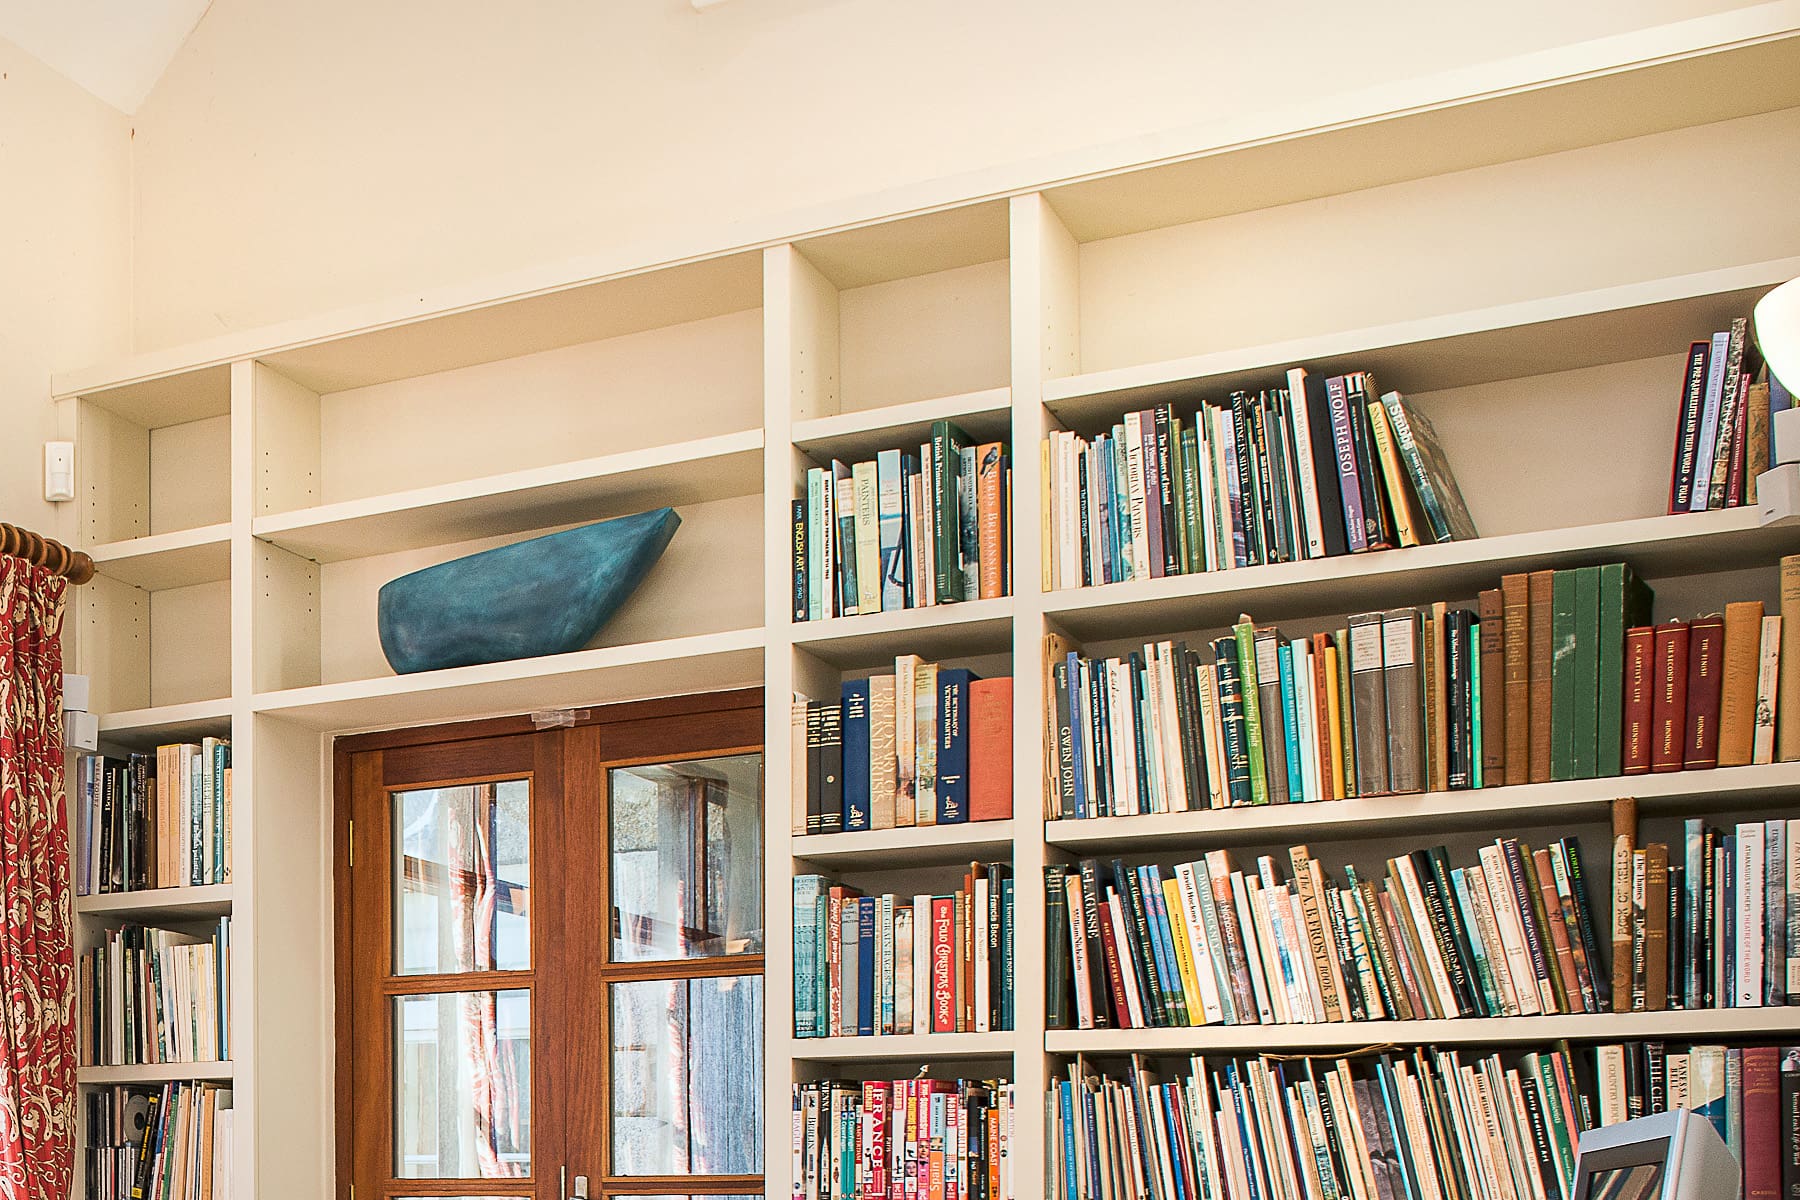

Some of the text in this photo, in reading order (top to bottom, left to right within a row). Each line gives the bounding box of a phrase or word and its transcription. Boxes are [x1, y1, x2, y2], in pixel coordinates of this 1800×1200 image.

[1330, 384, 1355, 477] JOSEPH WOLF
[1389, 404, 1416, 451] Stubbs
[1684, 434, 1695, 452] THEIR
[1686, 420, 1697, 432] AND
[1239, 455, 1249, 485] SILVER
[1681, 452, 1693, 474] WORLD
[861, 479, 871, 526] PAINTERS
[987, 471, 998, 506] BIRDS
[1128, 446, 1144, 538] VICTORIAN PAINTERS
[1678, 485, 1689, 504] FOLIO
[1186, 499, 1196, 526] YEATS
[795, 523, 805, 571] ENGLISH ART
[1198, 668, 1211, 715] SNAFFLES
[1633, 688, 1641, 703] LIFE
[1061, 726, 1073, 796] GWEN JOHN
[105, 772, 113, 811] Bonnard
[1556, 860, 1566, 881] Titian
[1569, 847, 1582, 879] HADRIAN
[1635, 857, 1644, 902] The Thames
[1127, 870, 1138, 887] The
[1136, 918, 1146, 936] Boys
[1182, 869, 1198, 923] David Hockney
[1197, 873, 1210, 901] DAVID
[936, 919, 950, 942] FOLIO
[991, 895, 1000, 948] Francis Bacon
[1086, 890, 1099, 938] AGASSE
[1222, 905, 1236, 943] Nicholson
[884, 918, 892, 948] GRAIN
[1300, 875, 1310, 890] The
[1308, 920, 1327, 962] FROST
[1319, 965, 1333, 992] BOOK
[1743, 963, 1751, 983] WORLD
[1670, 1066, 1679, 1089] BELL
[1679, 1058, 1688, 1098] VANESSA
[821, 1080, 830, 1112] VIENNA
[807, 1117, 817, 1150] BERLIN
[872, 1091, 884, 1168] FRANCE
[990, 1117, 998, 1166] MAINE COAST
[930, 1162, 942, 1191] Spain
